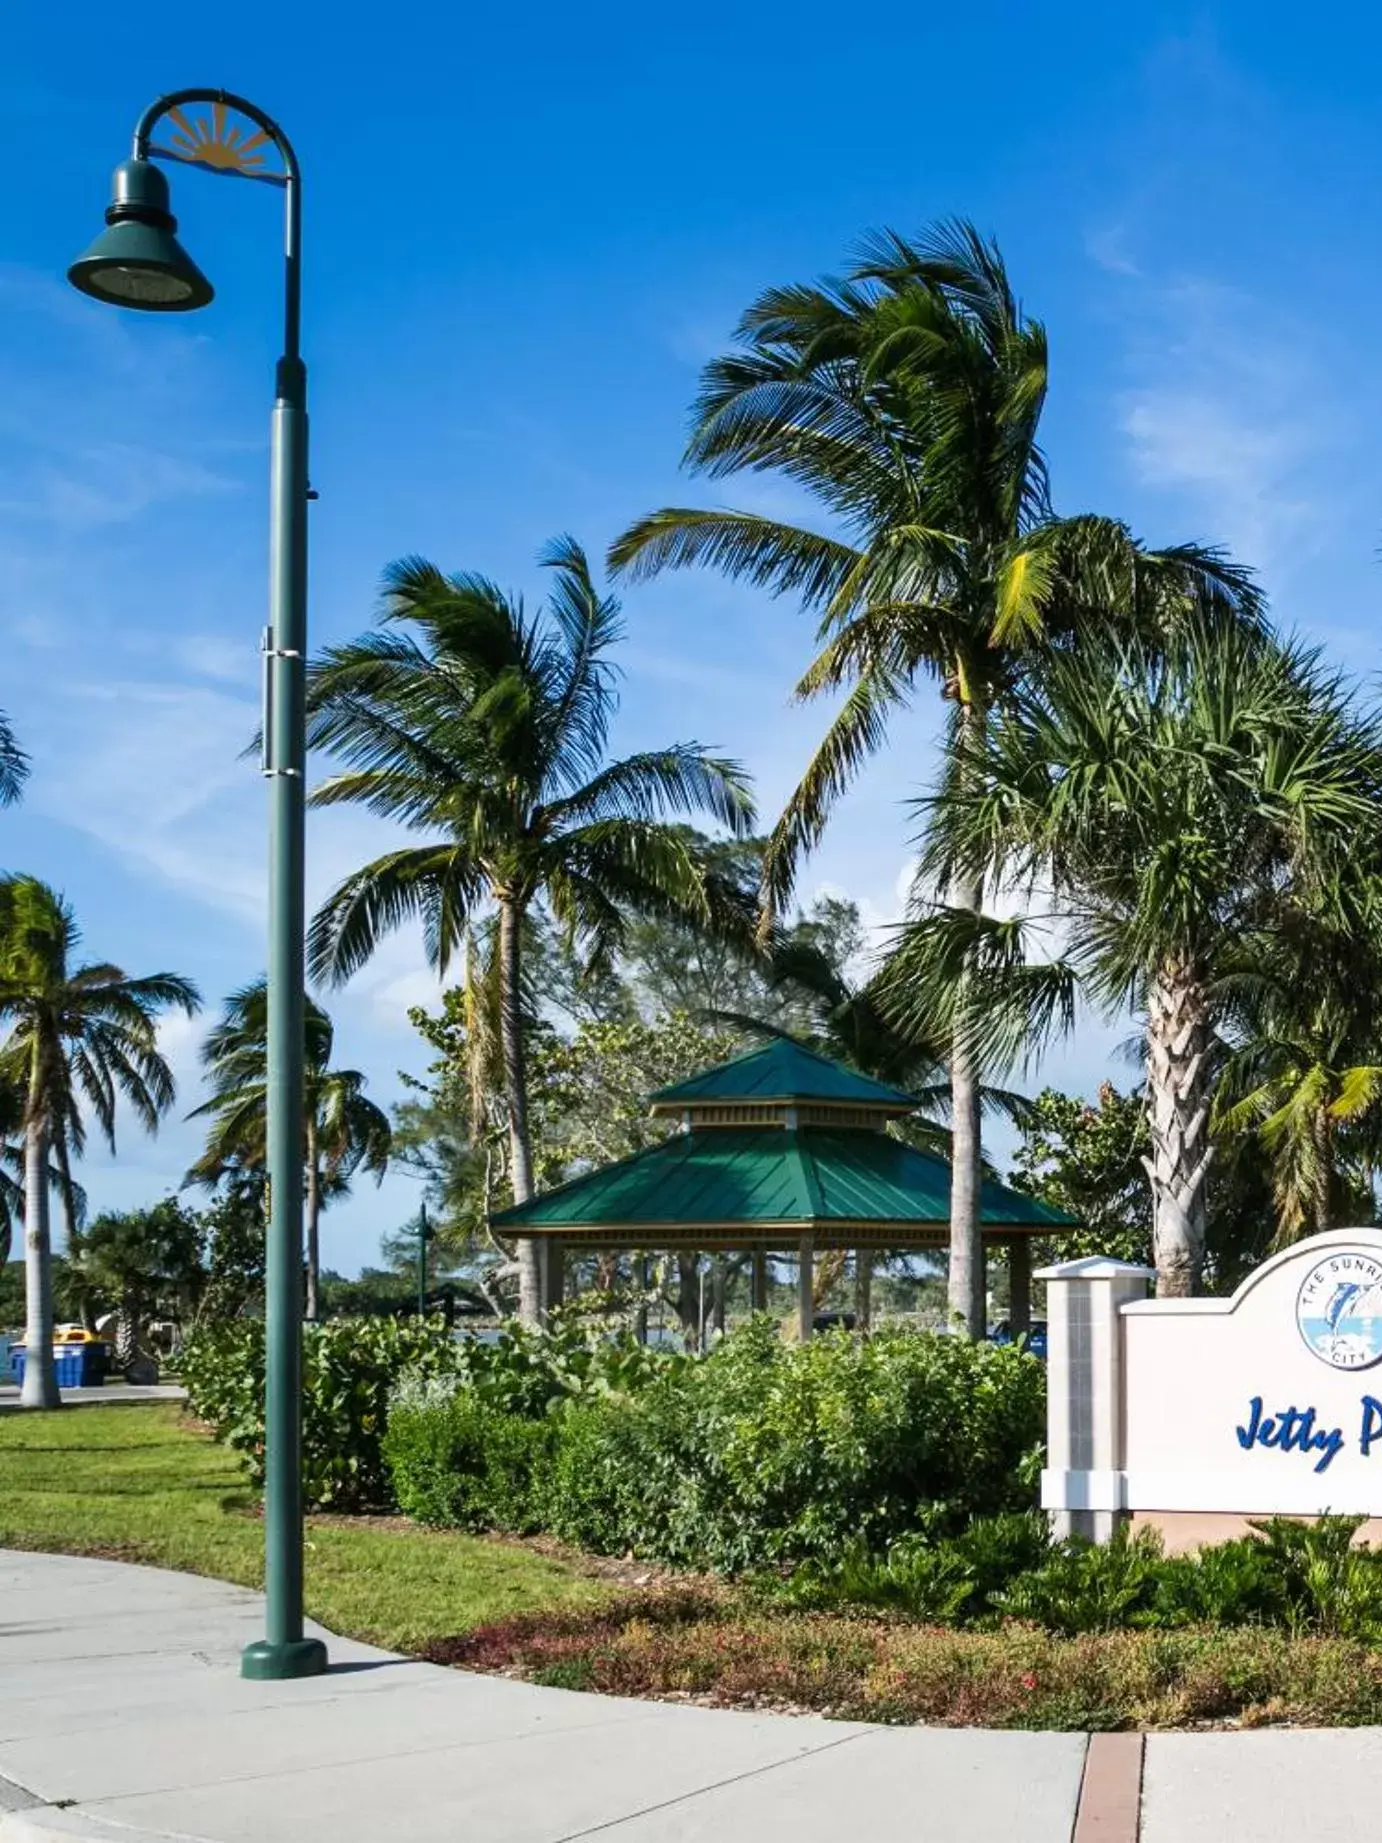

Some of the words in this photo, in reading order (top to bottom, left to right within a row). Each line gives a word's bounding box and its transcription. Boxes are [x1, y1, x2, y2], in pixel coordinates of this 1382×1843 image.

[1303, 1272, 1324, 1305] THE
[1332, 1352, 1365, 1364] CITY
[1236, 1396, 1345, 1474] Jetty
